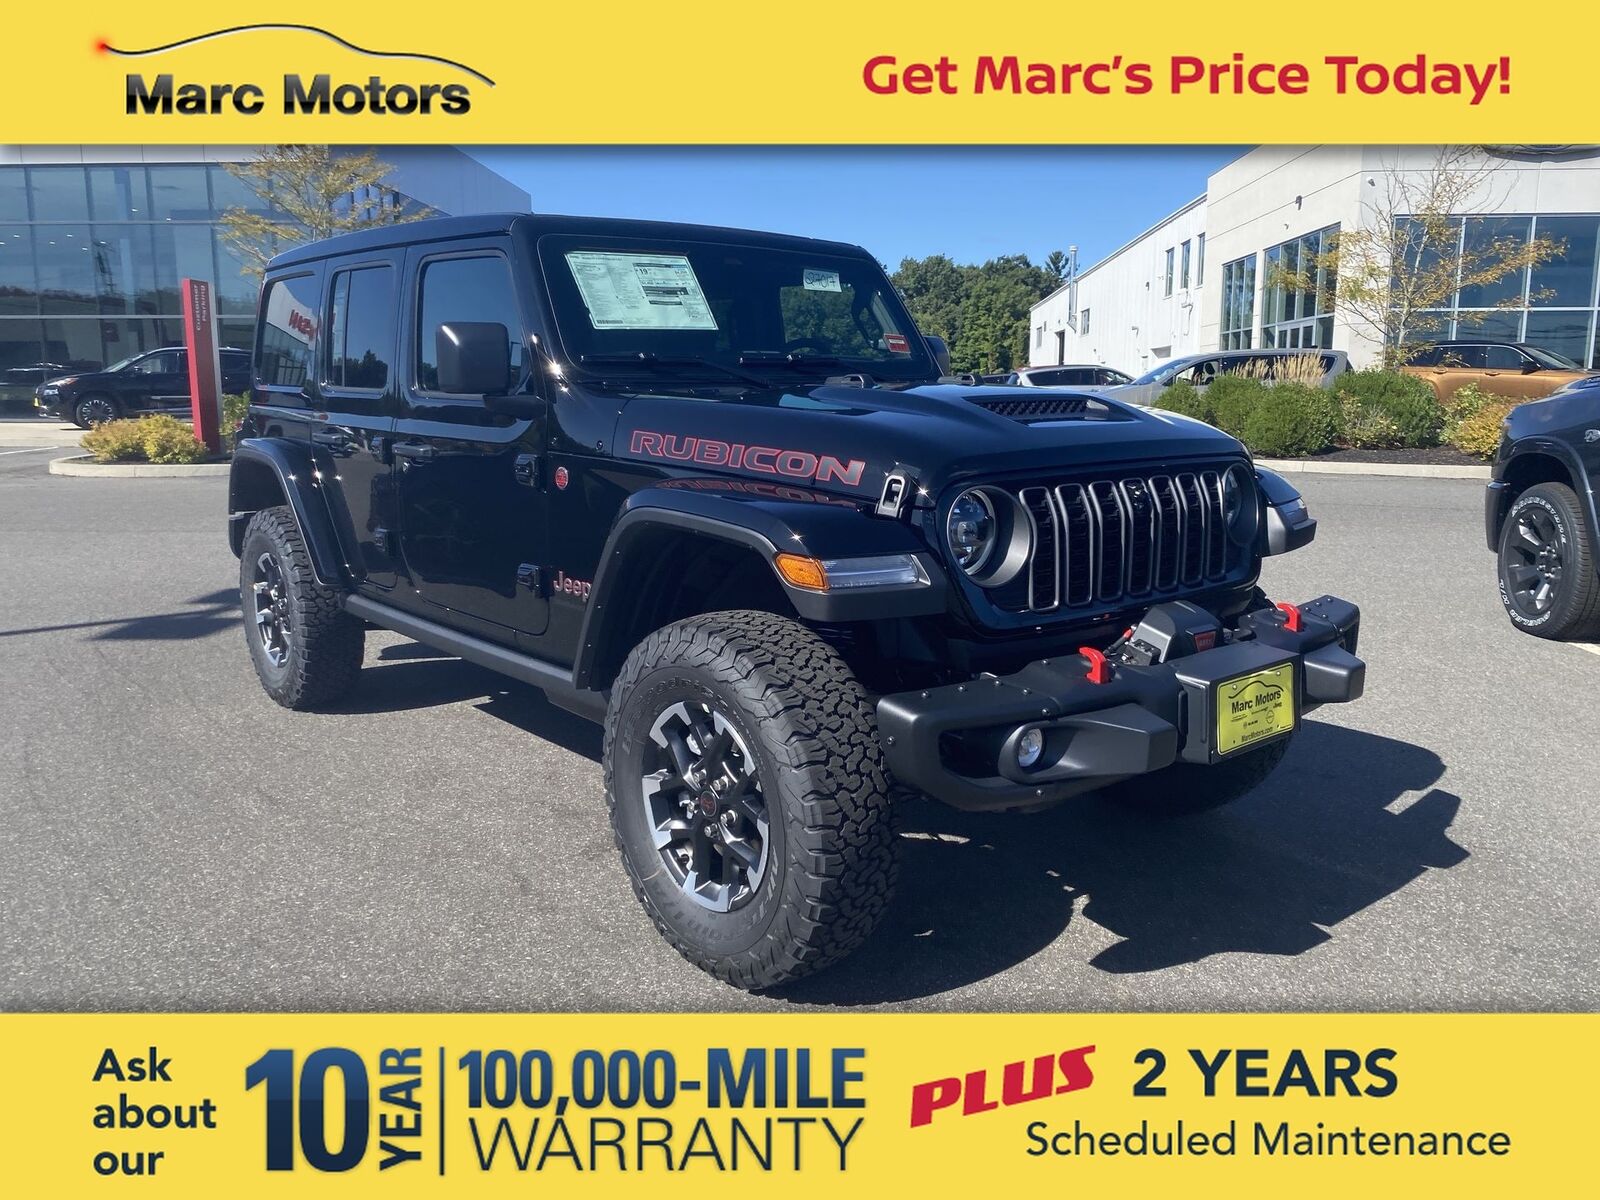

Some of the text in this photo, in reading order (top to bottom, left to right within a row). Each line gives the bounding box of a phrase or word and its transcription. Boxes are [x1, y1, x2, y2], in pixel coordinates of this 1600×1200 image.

[630, 430, 867, 487] RUBICON
[553, 570, 592, 602] Jeep
[1231, 700, 1253, 715] Marc
[1255, 690, 1282, 708] Motors
